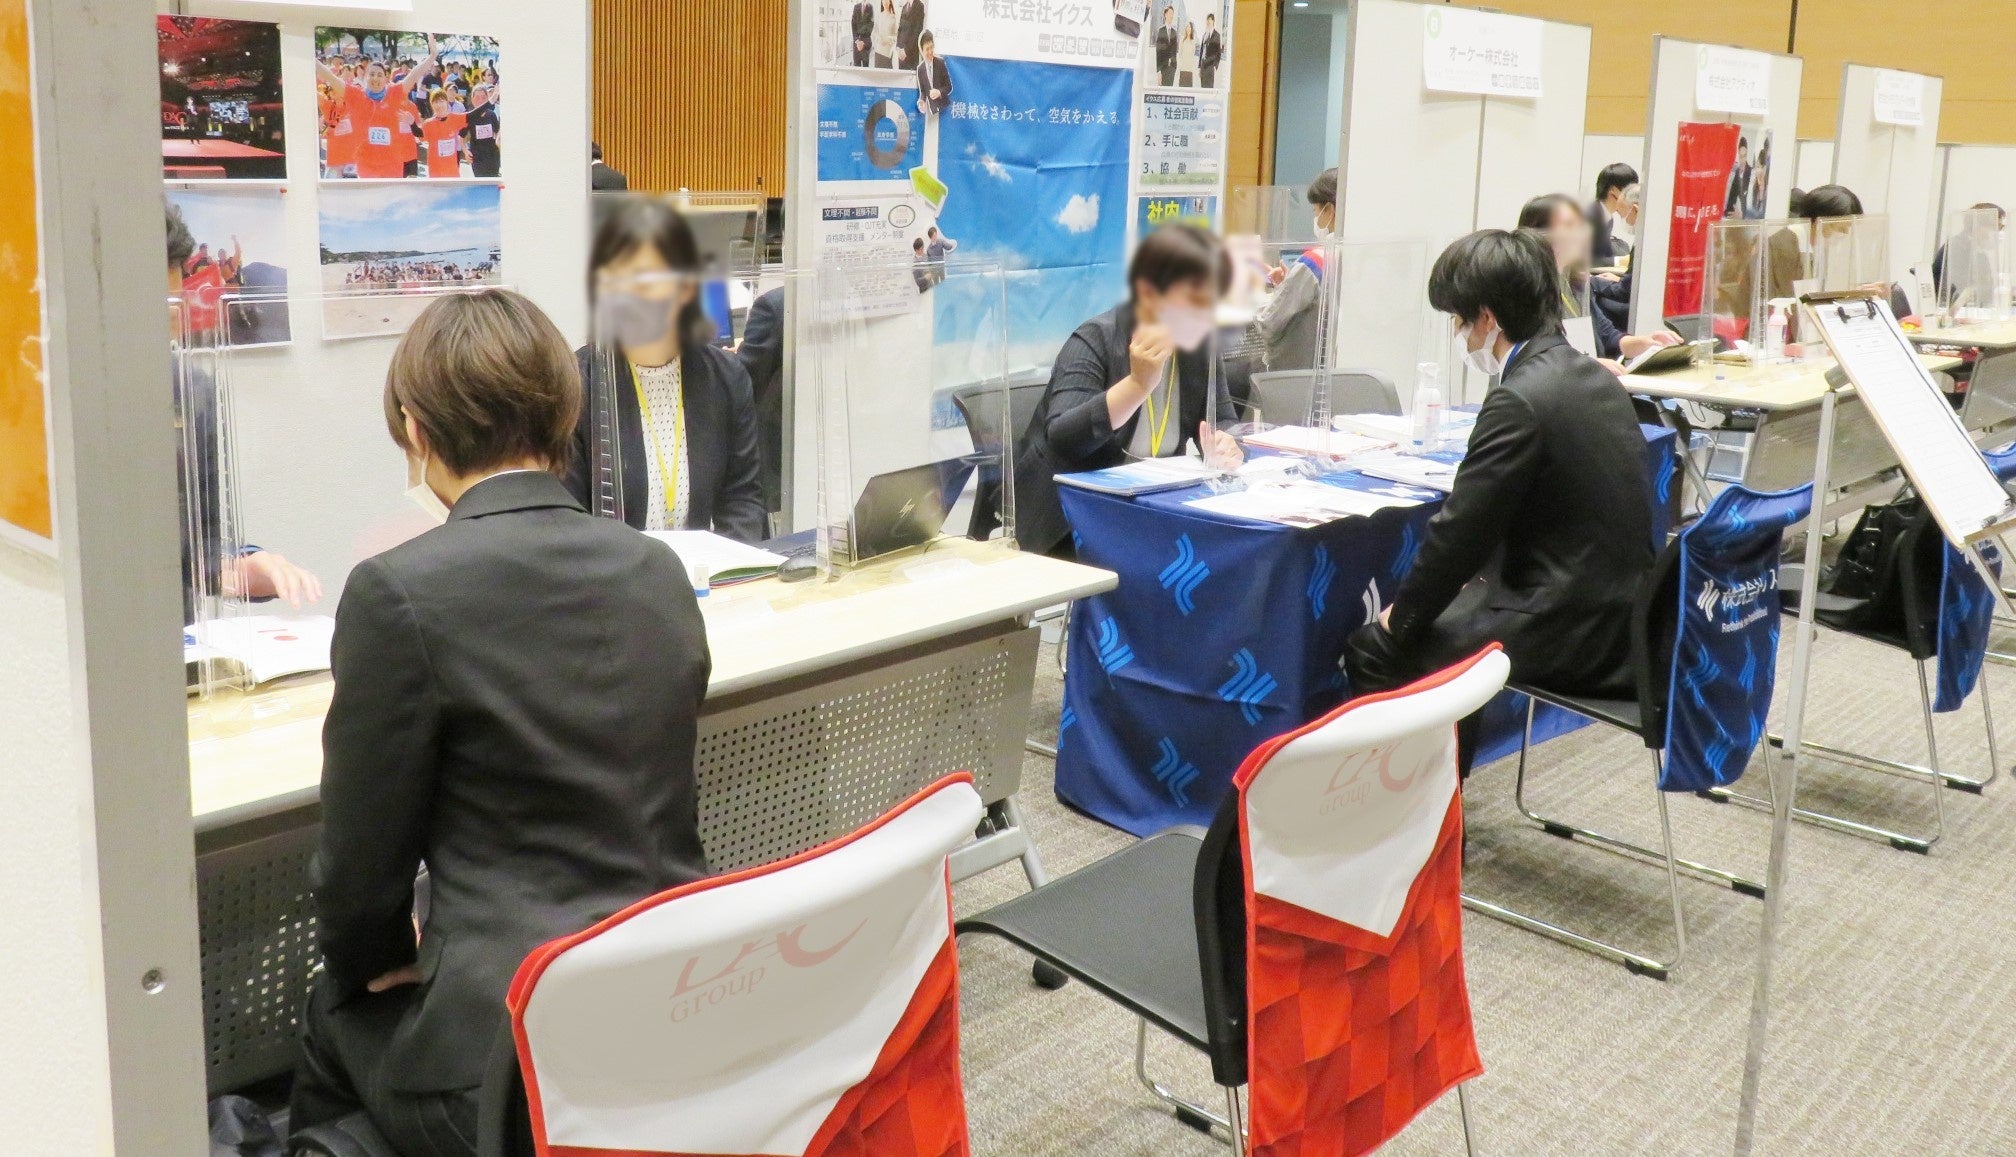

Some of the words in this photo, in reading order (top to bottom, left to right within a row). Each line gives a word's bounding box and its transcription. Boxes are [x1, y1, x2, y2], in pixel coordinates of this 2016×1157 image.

[1449, 44, 1519, 67] オーケー株式会社
[669, 966, 766, 1024] Group
